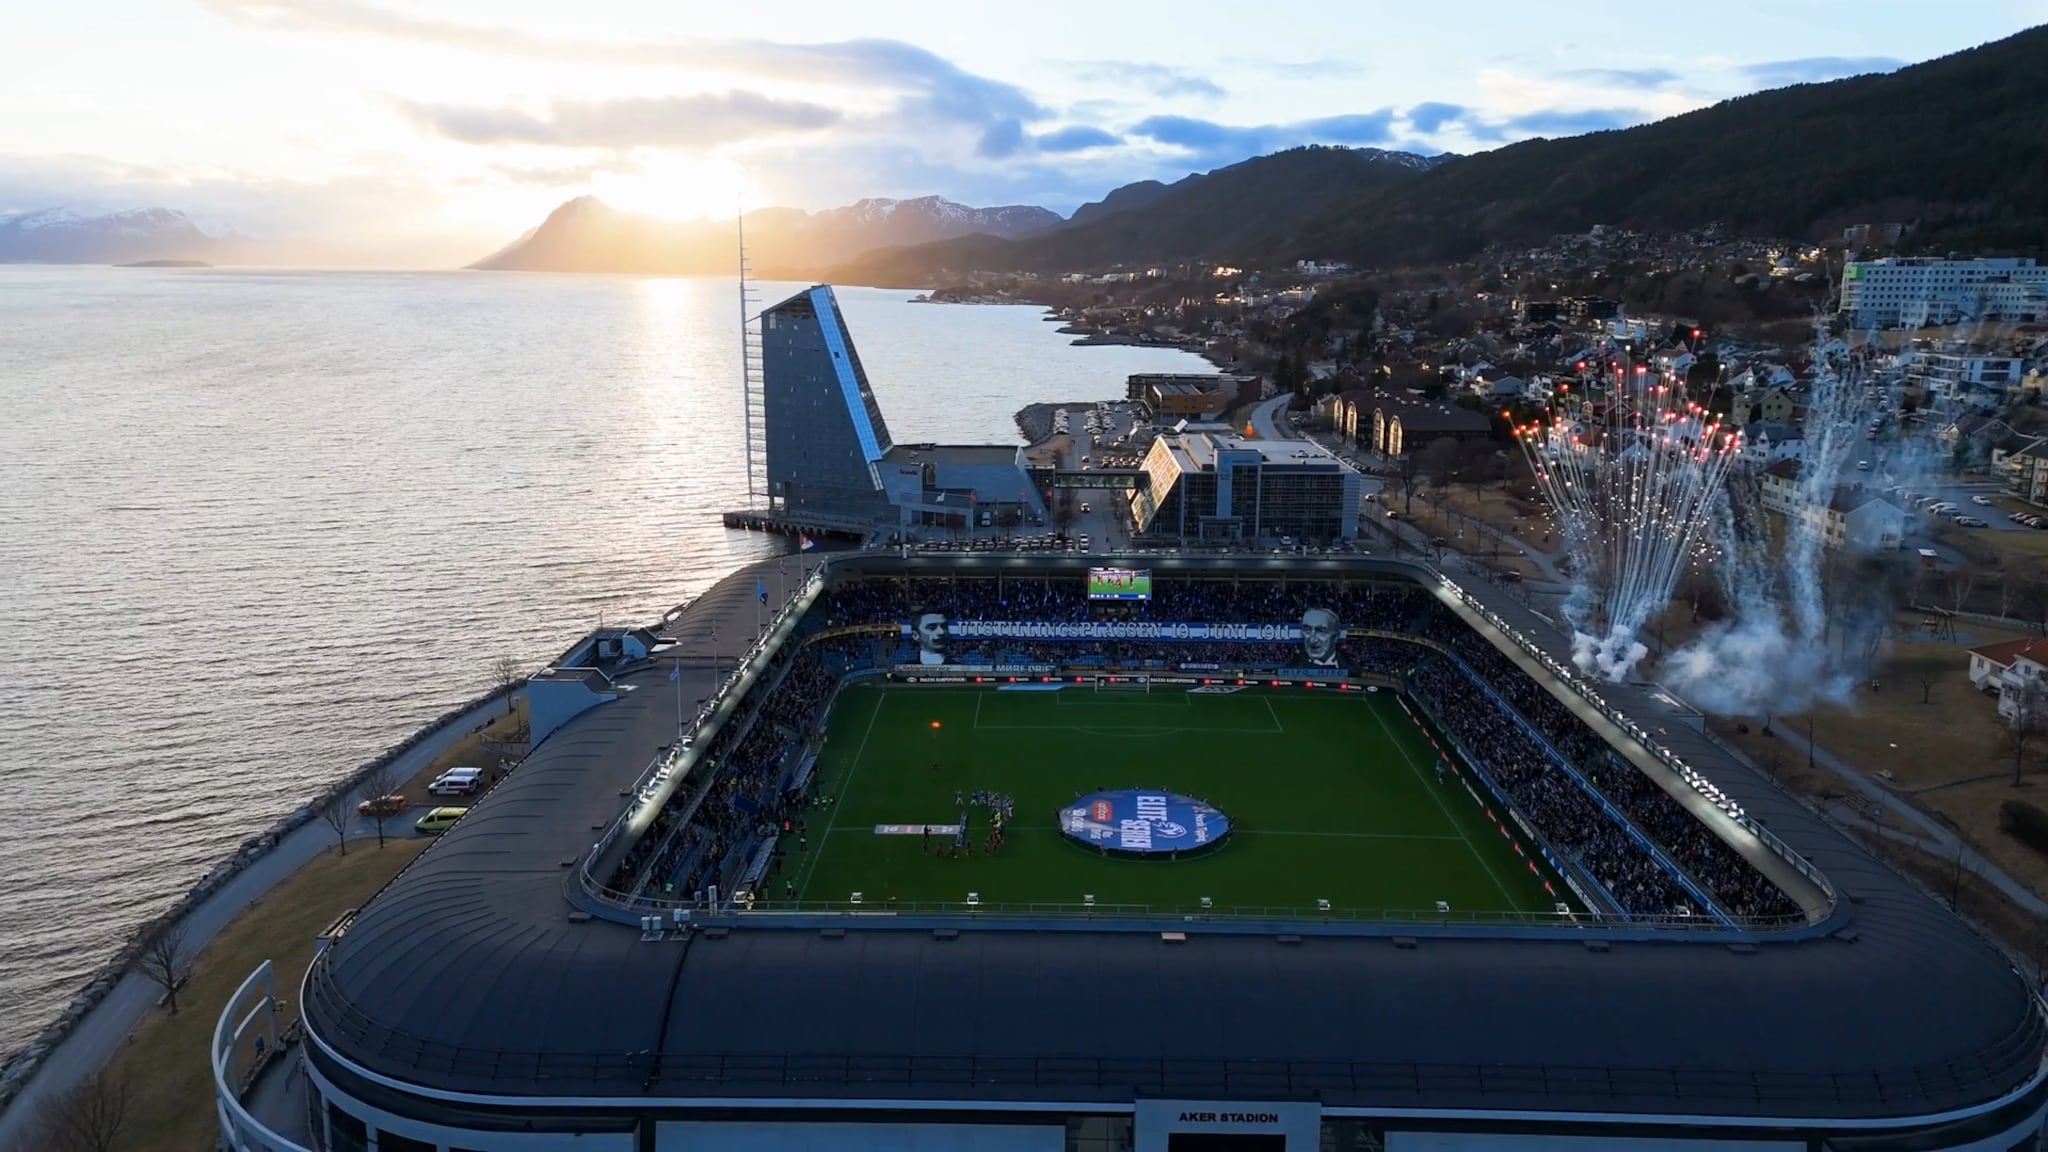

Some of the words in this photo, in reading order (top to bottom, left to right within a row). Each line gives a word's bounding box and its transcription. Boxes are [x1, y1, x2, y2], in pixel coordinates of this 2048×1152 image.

[957, 620, 1163, 639] UTSTILLINGSPLASSEN
[1171, 622, 1194, 639] 19.
[1201, 622, 1249, 640] JUNI
[1256, 623, 1291, 641] 1911
[1136, 795, 1168, 822] ELITE
[1120, 819, 1152, 849] SERIEN
[1178, 1112, 1217, 1123] AKER
[1219, 1112, 1279, 1124] STADION
